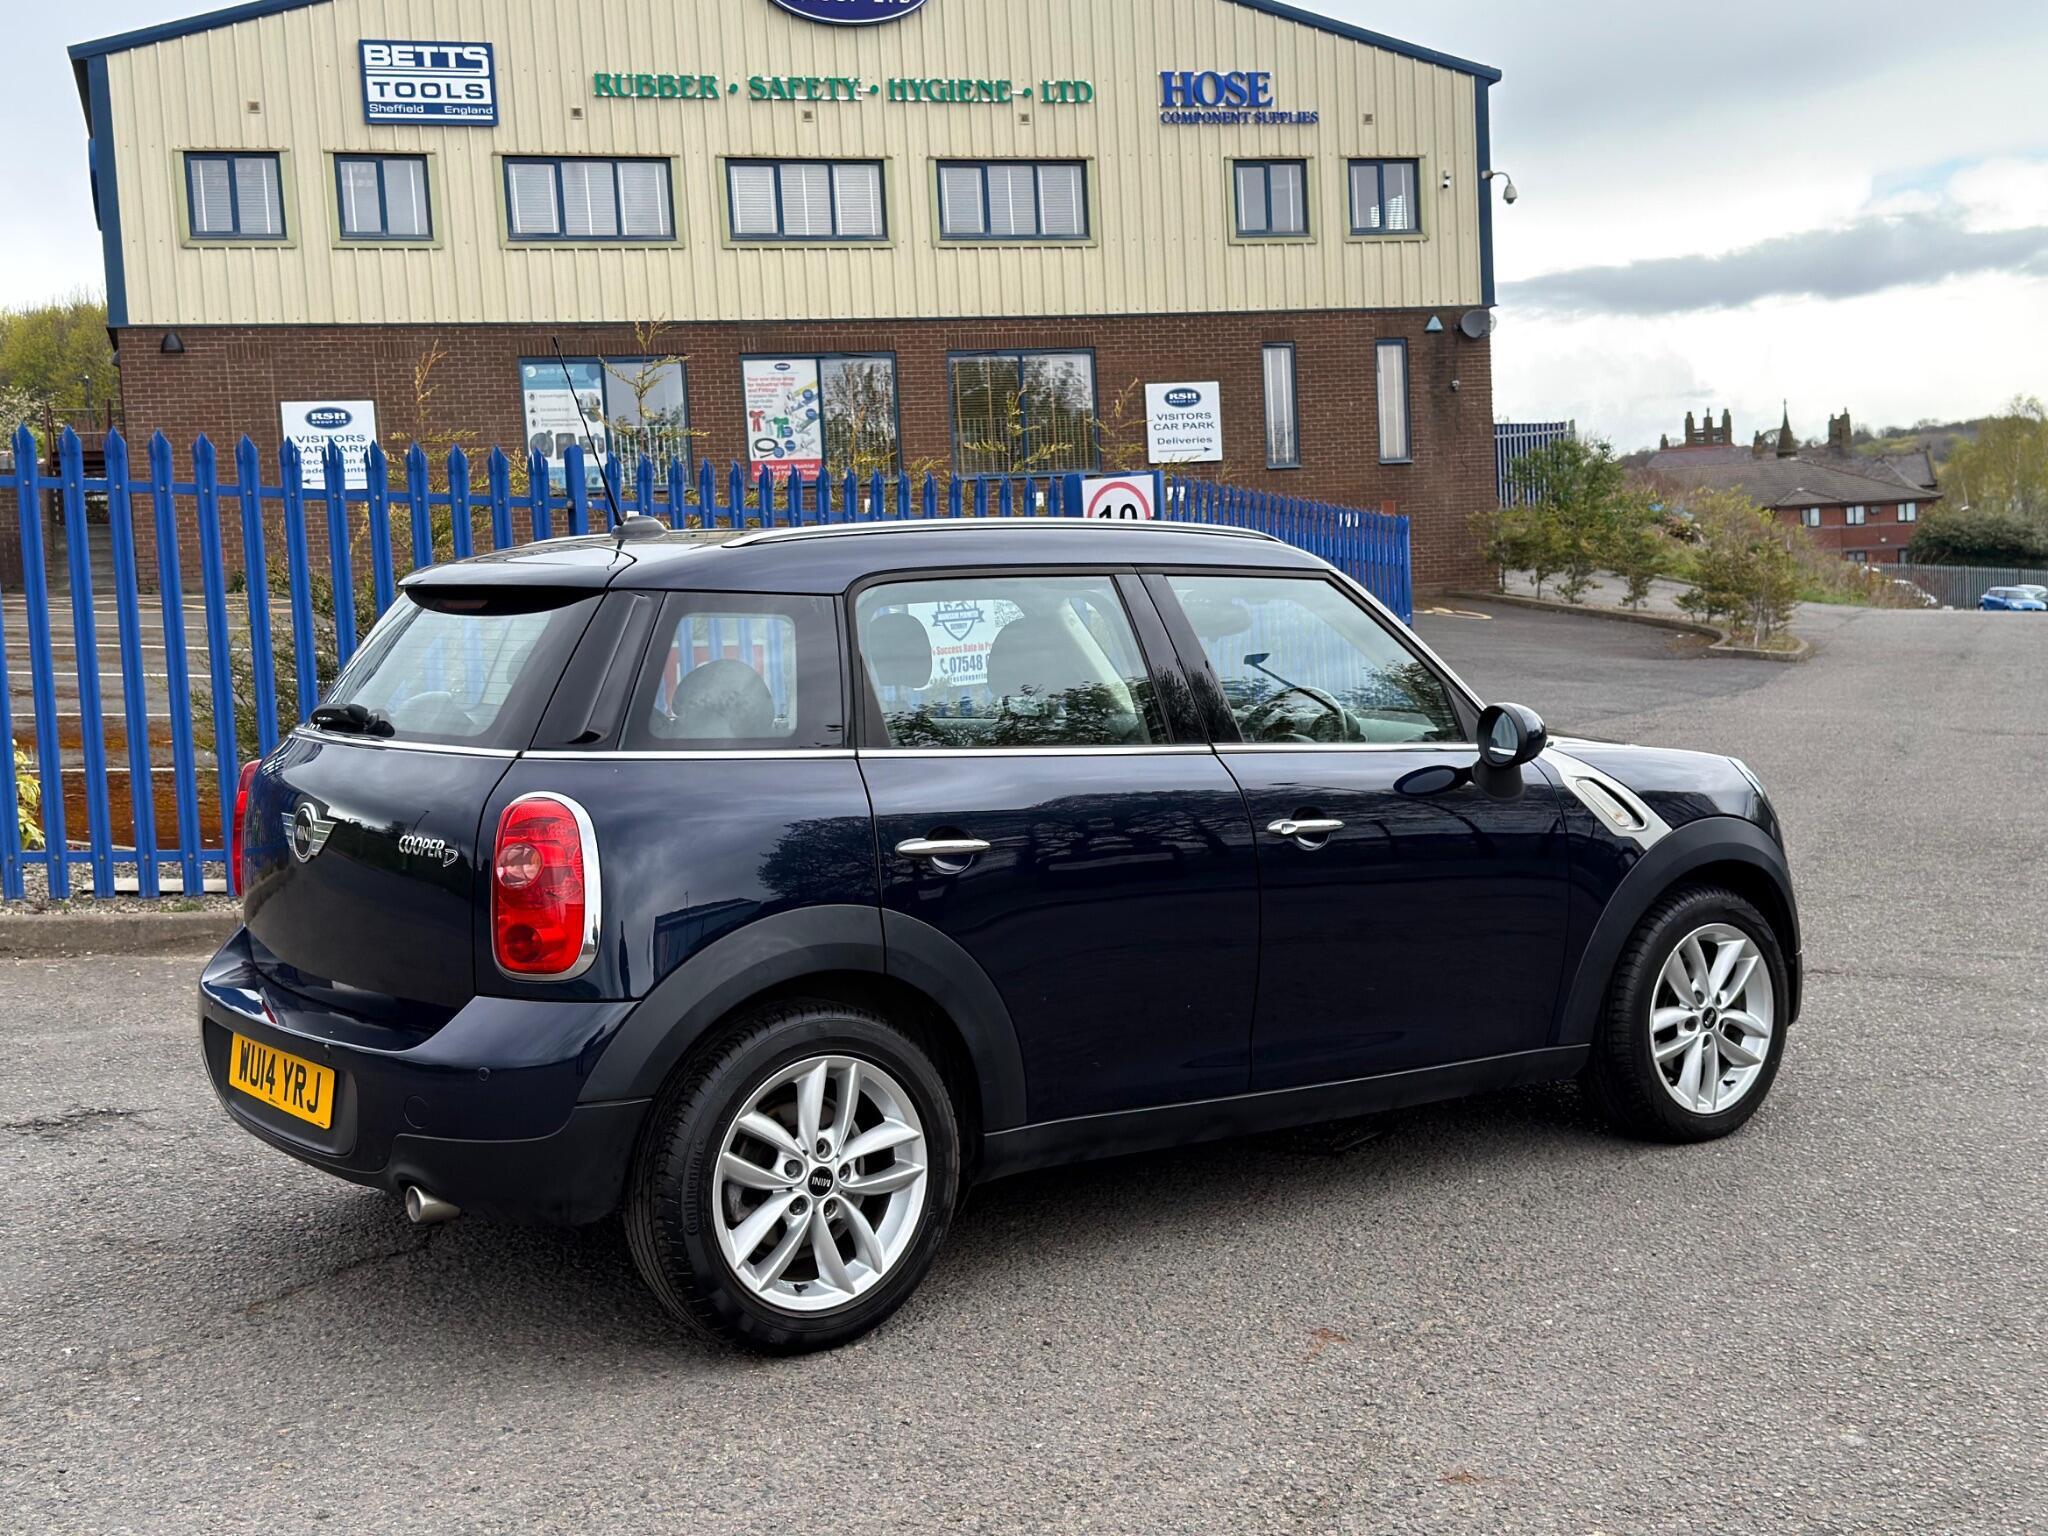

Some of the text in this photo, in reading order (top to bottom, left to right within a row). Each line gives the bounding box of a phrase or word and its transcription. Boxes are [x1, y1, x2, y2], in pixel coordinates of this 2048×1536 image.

[363, 44, 489, 77] BETTS
[372, 81, 485, 99] TOOLS
[593, 73, 1094, 104] RUBBER SAFETY HYGIENE LTD
[1158, 70, 1274, 108] HOSE
[369, 103, 493, 115] Sheffield England
[1160, 111, 1319, 124] COMPONENT SUPPLIES
[1156, 412, 1212, 421] VISITORS
[1153, 422, 1215, 431] CAR PARK
[1157, 437, 1213, 445] Deliveries
[950, 654, 983, 673] 07548
[398, 834, 446, 859] COOPER
[239, 1039, 322, 1114] WU14 YRJ
[812, 1176, 831, 1188] MINI
